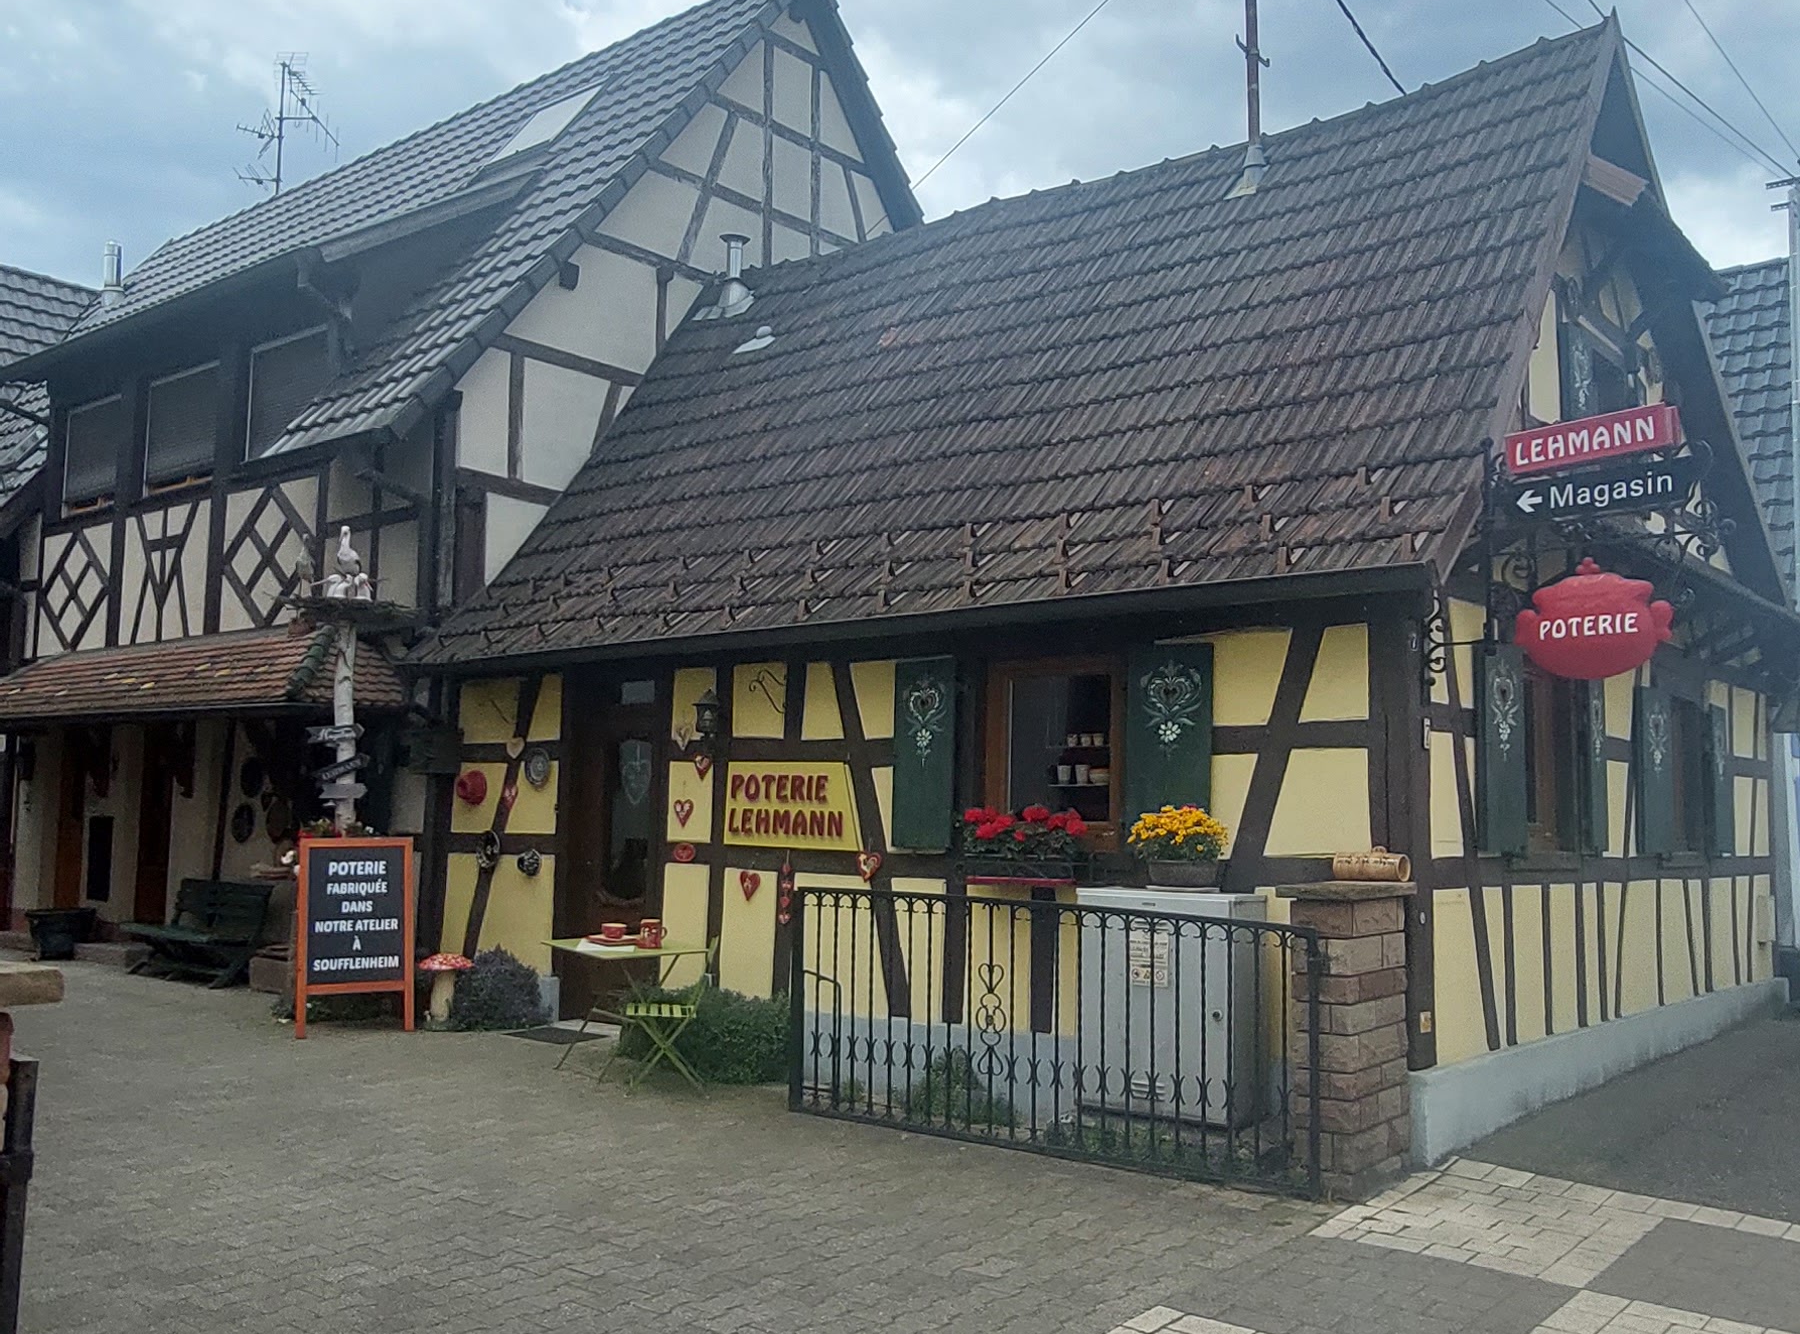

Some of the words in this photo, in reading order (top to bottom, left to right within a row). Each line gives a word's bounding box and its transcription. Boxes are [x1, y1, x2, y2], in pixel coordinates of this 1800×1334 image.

[1515, 416, 1655, 466] LEHMANN
[1550, 472, 1673, 509] Magasin
[1540, 613, 1639, 641] POTERIE
[730, 773, 829, 802] POTERIE
[728, 807, 844, 838] LEHMANN
[328, 860, 387, 876] POTERIE
[326, 878, 388, 897] FABRIQUÉE
[341, 900, 374, 913] DANS
[314, 919, 354, 934] NOTRE
[354, 918, 399, 932] ATELIER
[352, 934, 362, 951] À
[313, 955, 400, 972] SOUFFLENHEIM
